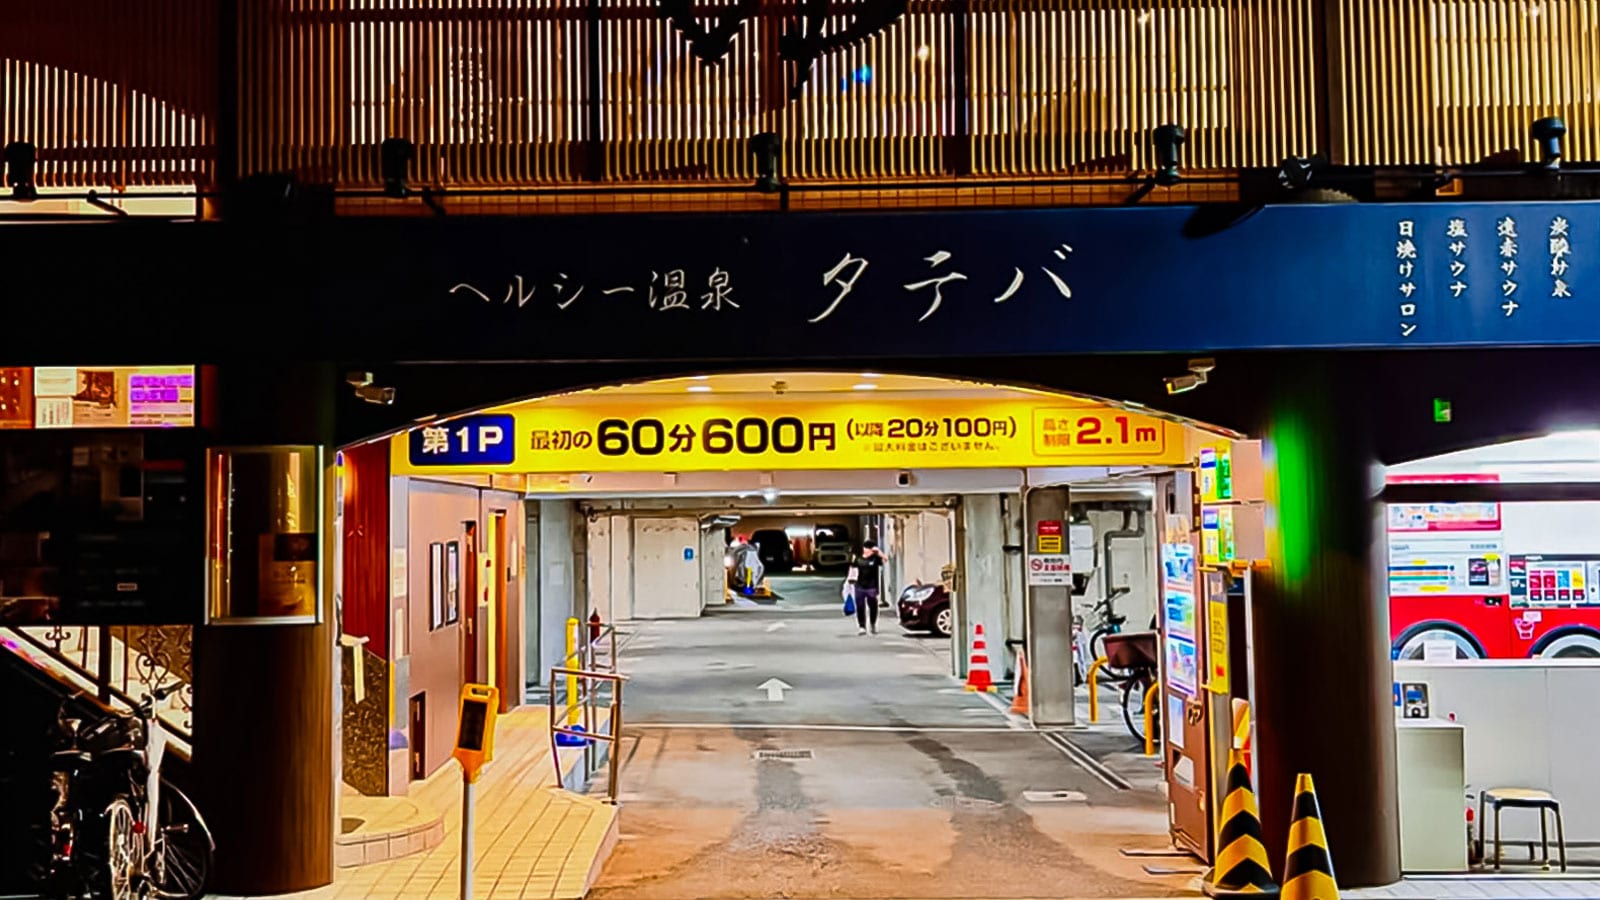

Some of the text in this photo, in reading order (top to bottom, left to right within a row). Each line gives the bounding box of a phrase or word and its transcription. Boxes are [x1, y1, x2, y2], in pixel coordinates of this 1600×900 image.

[448, 243, 1074, 323] ヘルシー温泉 タテバ
[1396, 221, 1417, 337] 日焼けサロン
[1446, 218, 1468, 298] 塩サウナ
[422, 425, 503, 454] 第1P
[531, 417, 836, 456] 最初の60分600円
[1077, 416, 1156, 445] 2.1m
